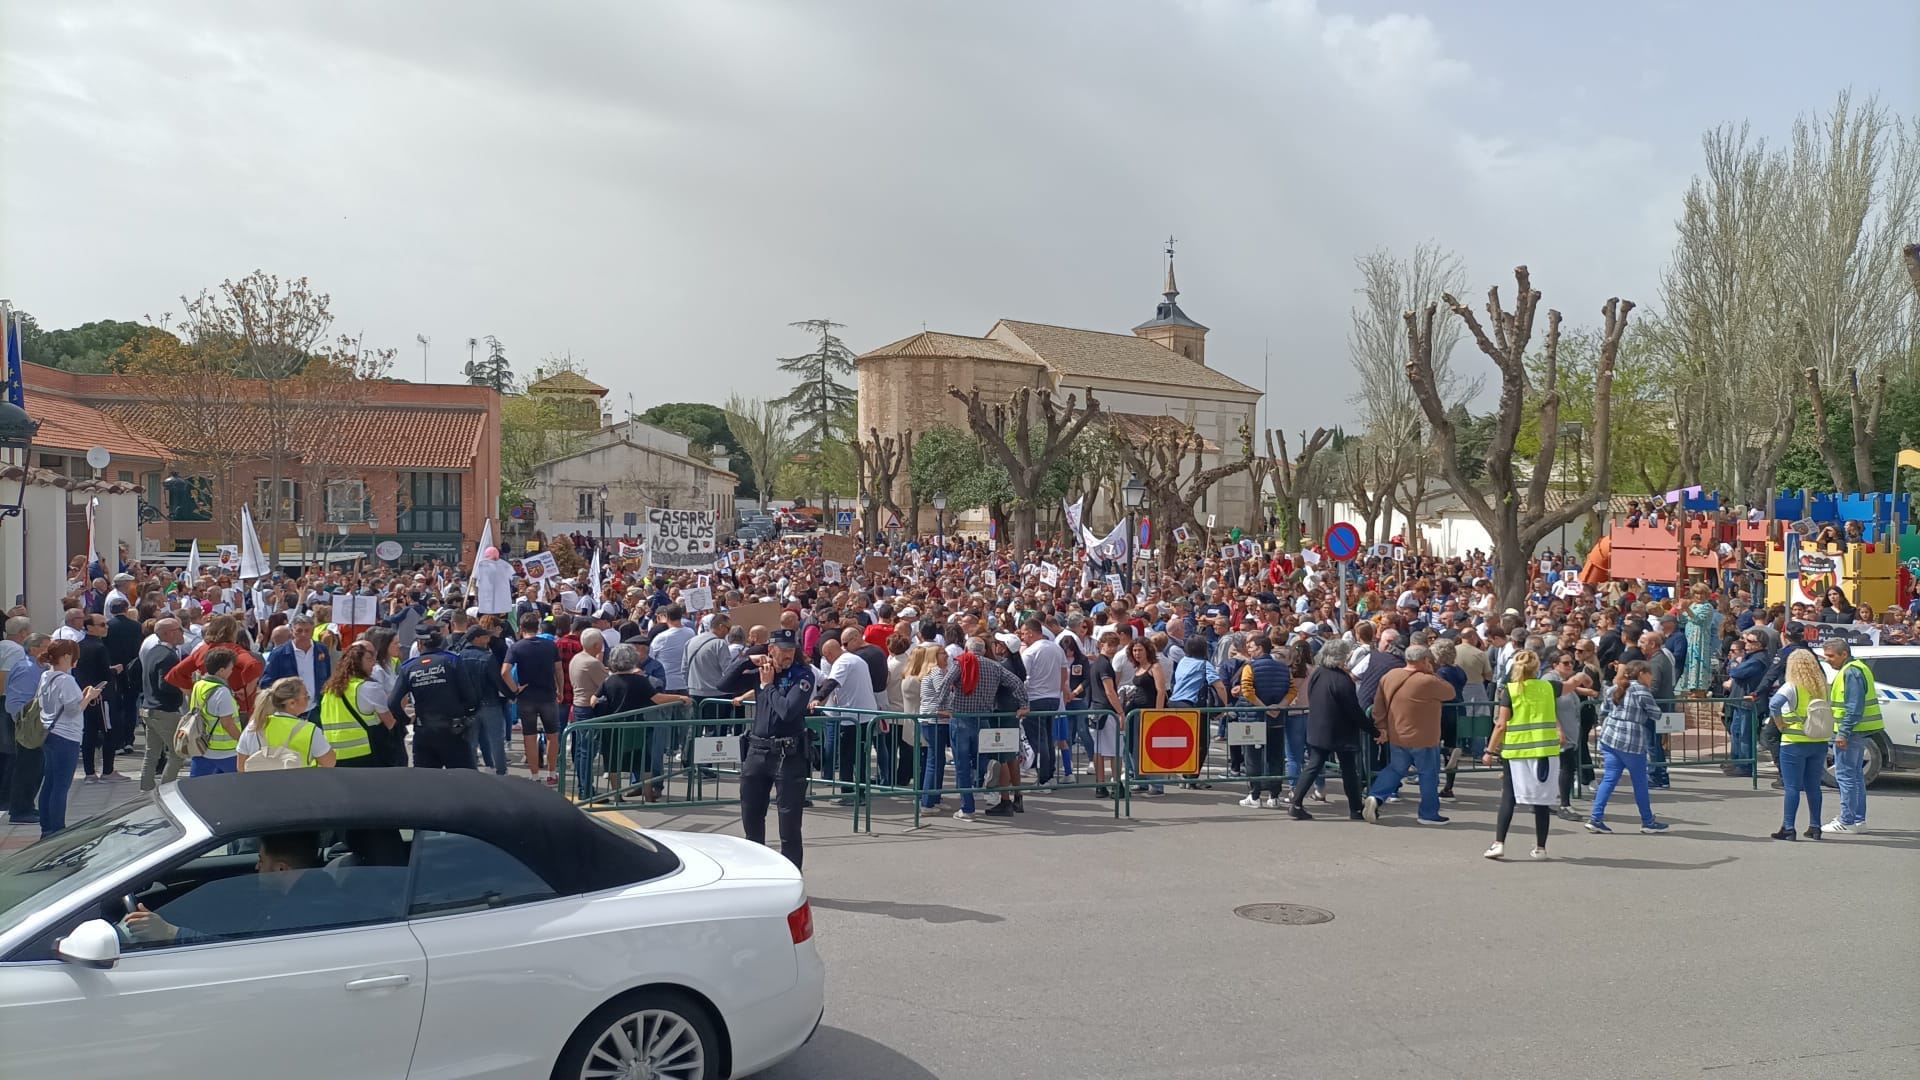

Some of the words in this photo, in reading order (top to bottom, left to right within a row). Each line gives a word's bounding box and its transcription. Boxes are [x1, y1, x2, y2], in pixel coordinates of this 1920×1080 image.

[649, 509, 715, 525] CASARRU
[660, 524, 713, 539] BUELOS
[651, 535, 679, 552] NO
[687, 539, 699, 552] A
[1804, 628, 1819, 641] NO
